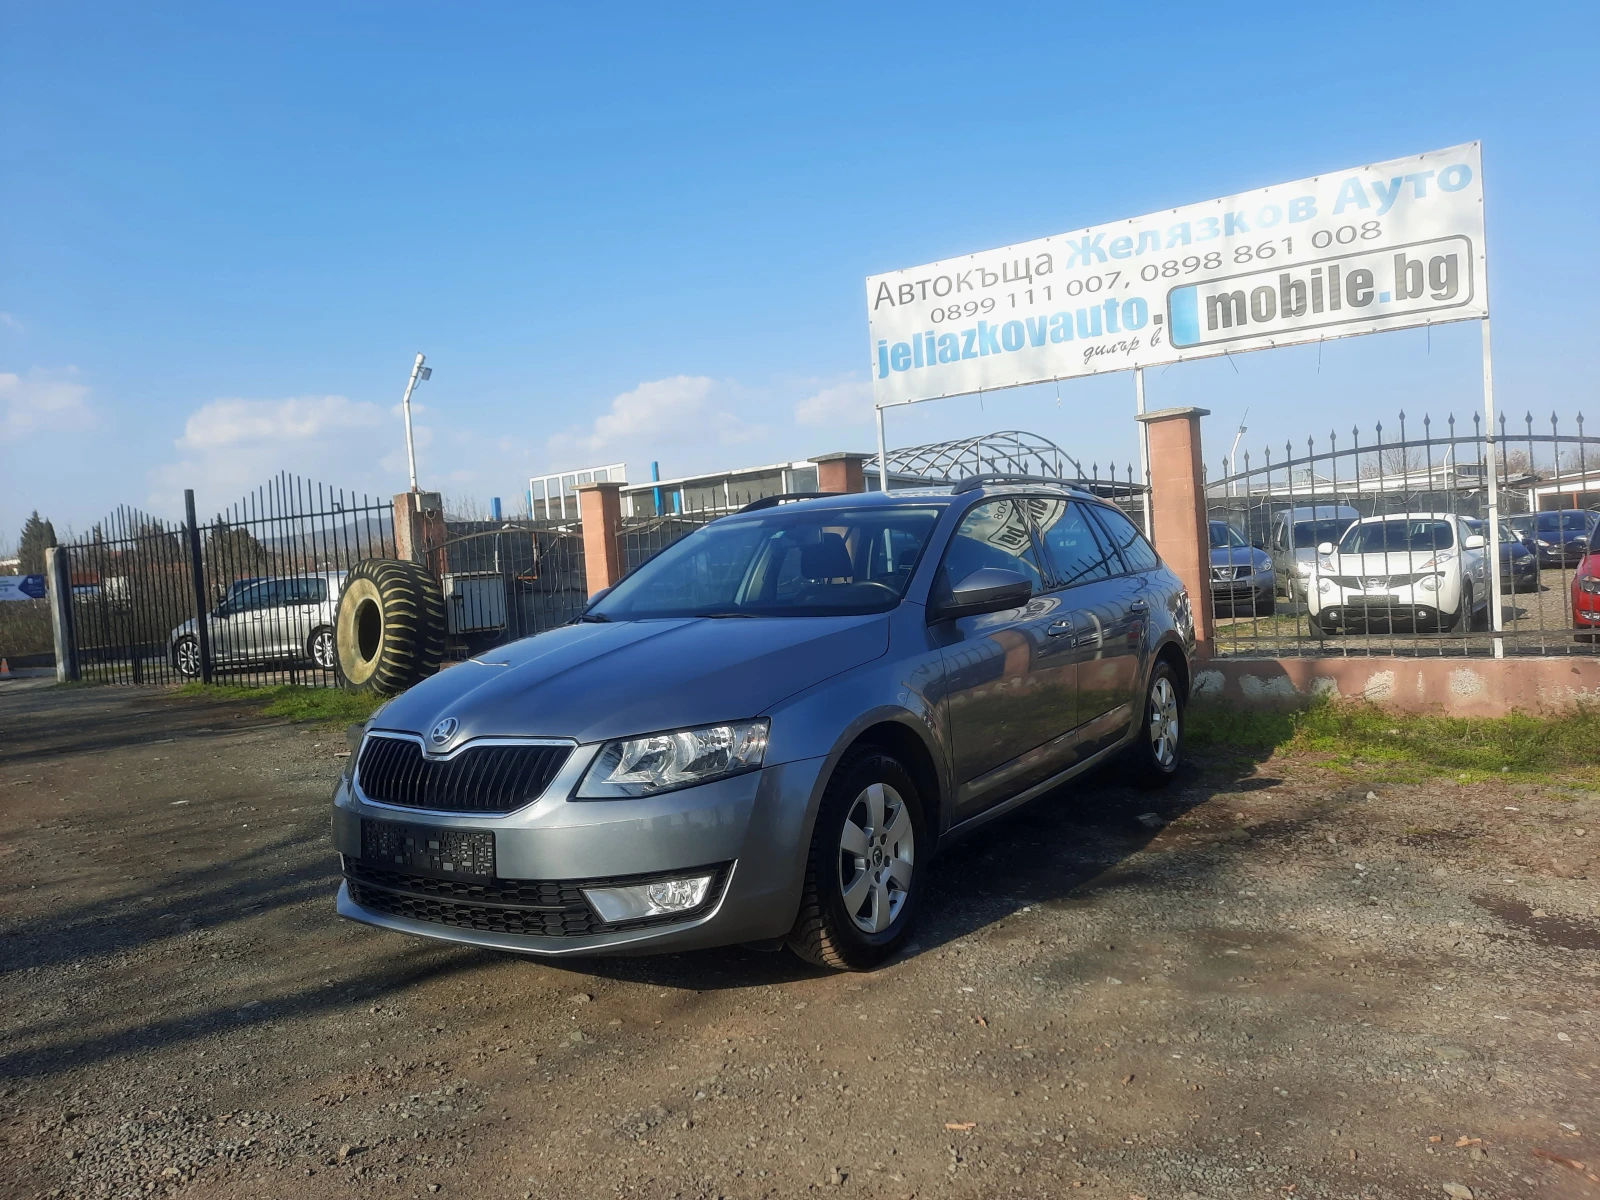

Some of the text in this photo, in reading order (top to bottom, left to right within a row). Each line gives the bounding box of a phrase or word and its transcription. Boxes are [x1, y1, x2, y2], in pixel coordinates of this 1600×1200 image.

[874, 163, 1473, 310] Автокъща Желязков Ауто
[930, 220, 1383, 324] 0899 111 007, 0898 861 008
[1205, 252, 1459, 331] mobile.bg
[1083, 327, 1162, 365] дилър в
